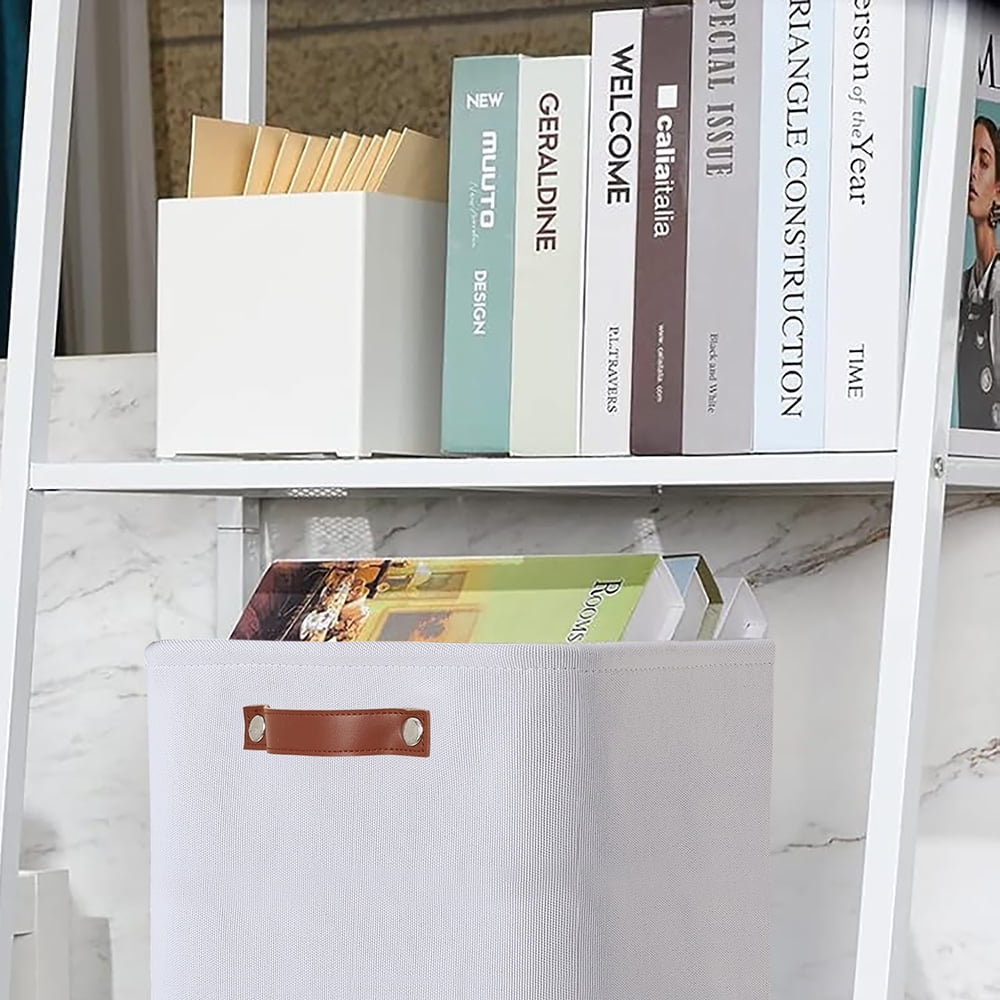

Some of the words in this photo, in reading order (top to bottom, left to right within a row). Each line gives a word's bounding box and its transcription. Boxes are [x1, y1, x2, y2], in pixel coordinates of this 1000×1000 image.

[466, 92, 504, 111] NEW
[607, 44, 635, 205] WELCOME
[848, 86, 867, 105] of
[851, 111, 865, 138] the
[535, 92, 560, 252] GERALDINE
[706, 103, 735, 176] ISSUE
[849, 133, 874, 205] Year
[653, 114, 676, 238] caliaitalia
[472, 270, 488, 335] DESIGN
[780, 156, 808, 417] CONSTRUCTION
[848, 343, 865, 398] TIME
